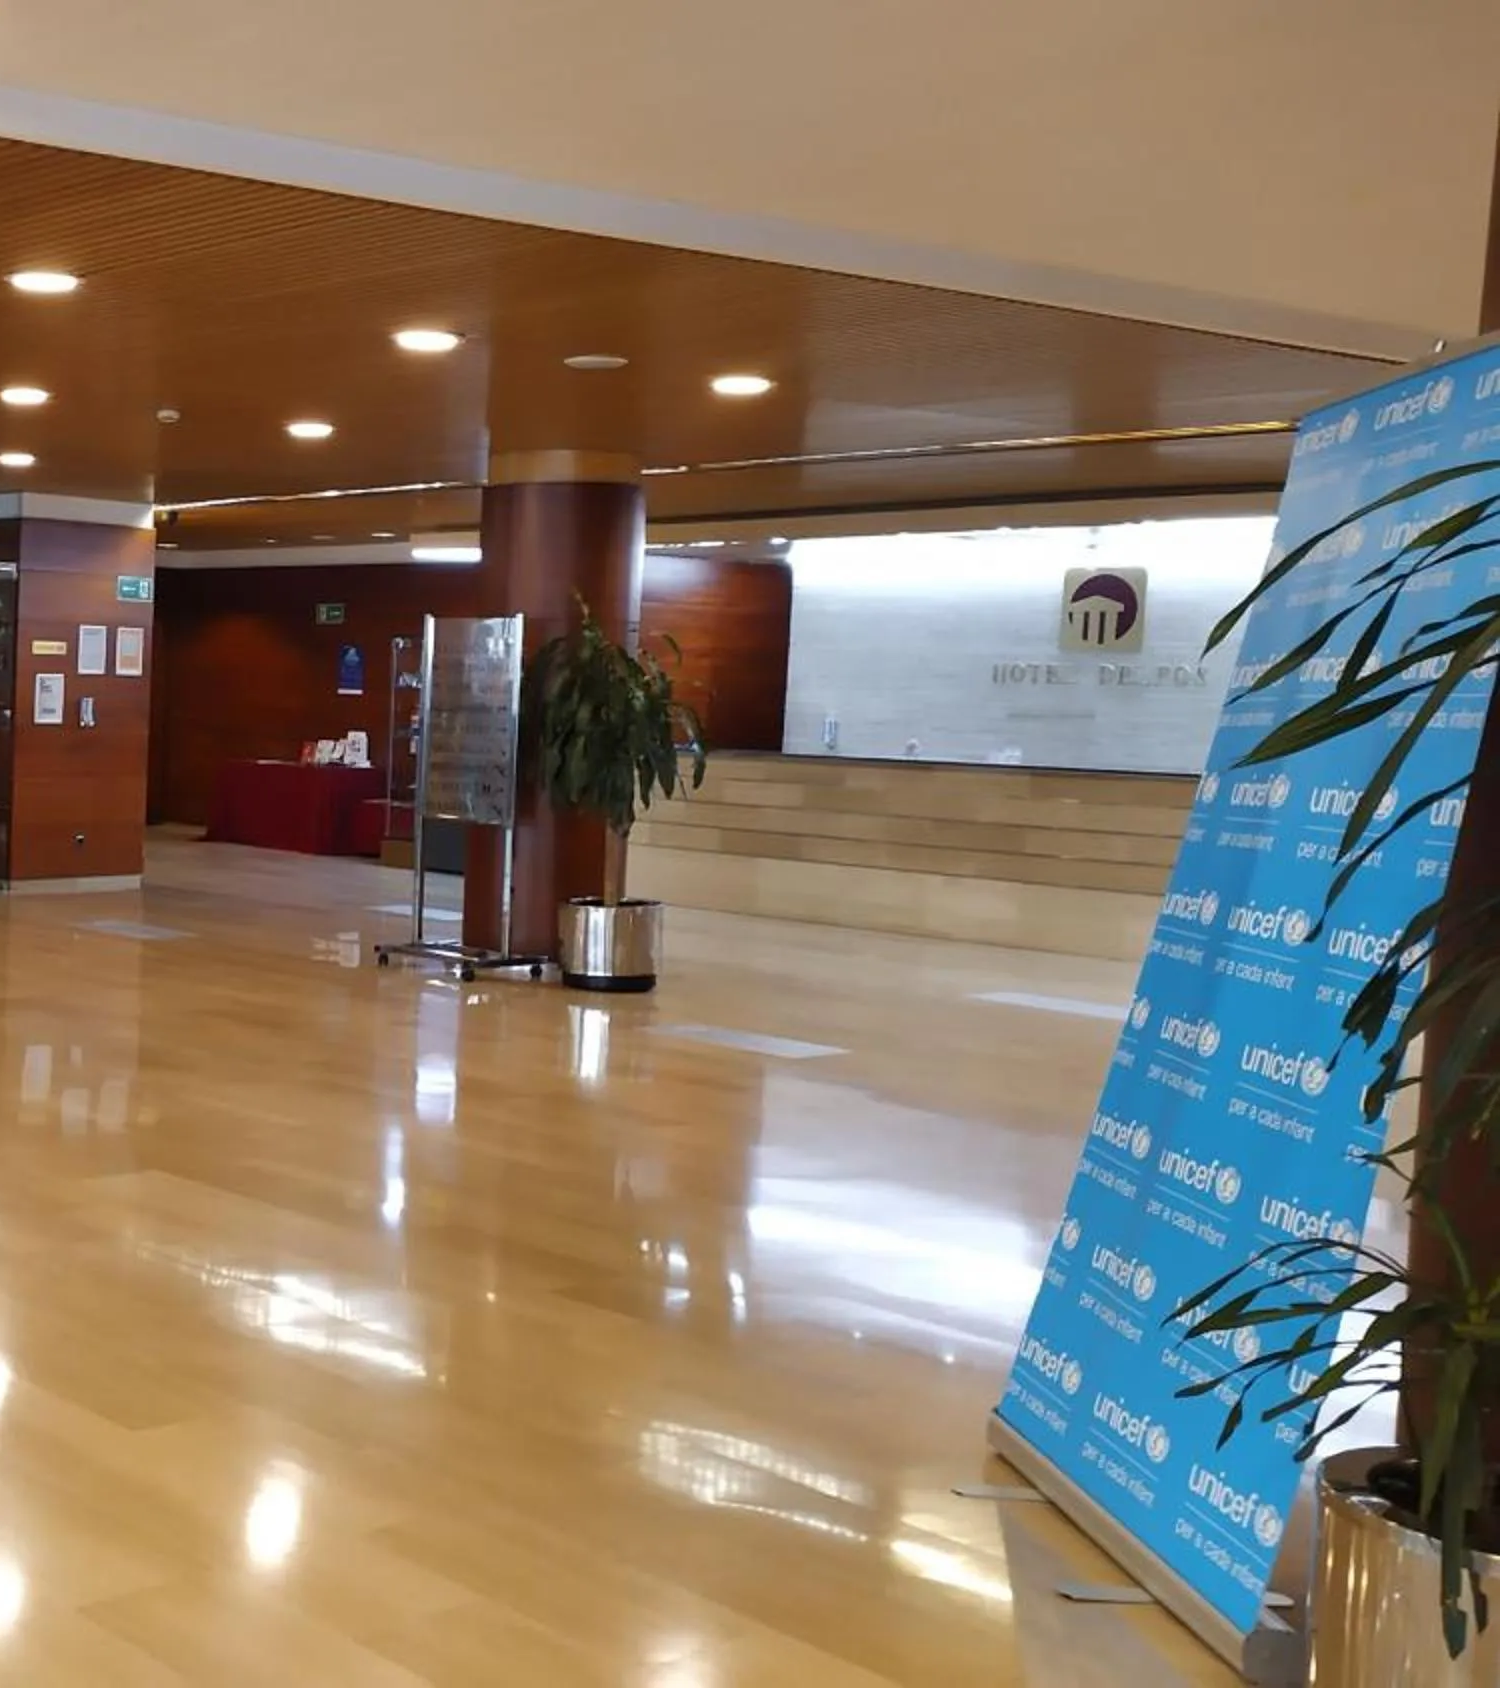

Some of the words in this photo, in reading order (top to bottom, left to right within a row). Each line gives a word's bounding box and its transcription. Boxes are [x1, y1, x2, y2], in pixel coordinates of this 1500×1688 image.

[1374, 380, 1434, 431] unicef
[1230, 773, 1276, 807] unicef
[1310, 779, 1363, 817] unic
[1162, 887, 1207, 921] unicef
[1227, 899, 1287, 940] unicef
[1160, 1011, 1205, 1052] unicef
[1241, 1042, 1305, 1087] unicef
[1092, 1112, 1137, 1150] unicef
[1159, 1147, 1220, 1193] unicef
[1261, 1195, 1333, 1246] unicef
[1091, 1243, 1138, 1289] unicef
[1019, 1334, 1068, 1384] unicef
[1093, 1391, 1151, 1448] unicef
[1187, 1463, 1260, 1529] unicef
